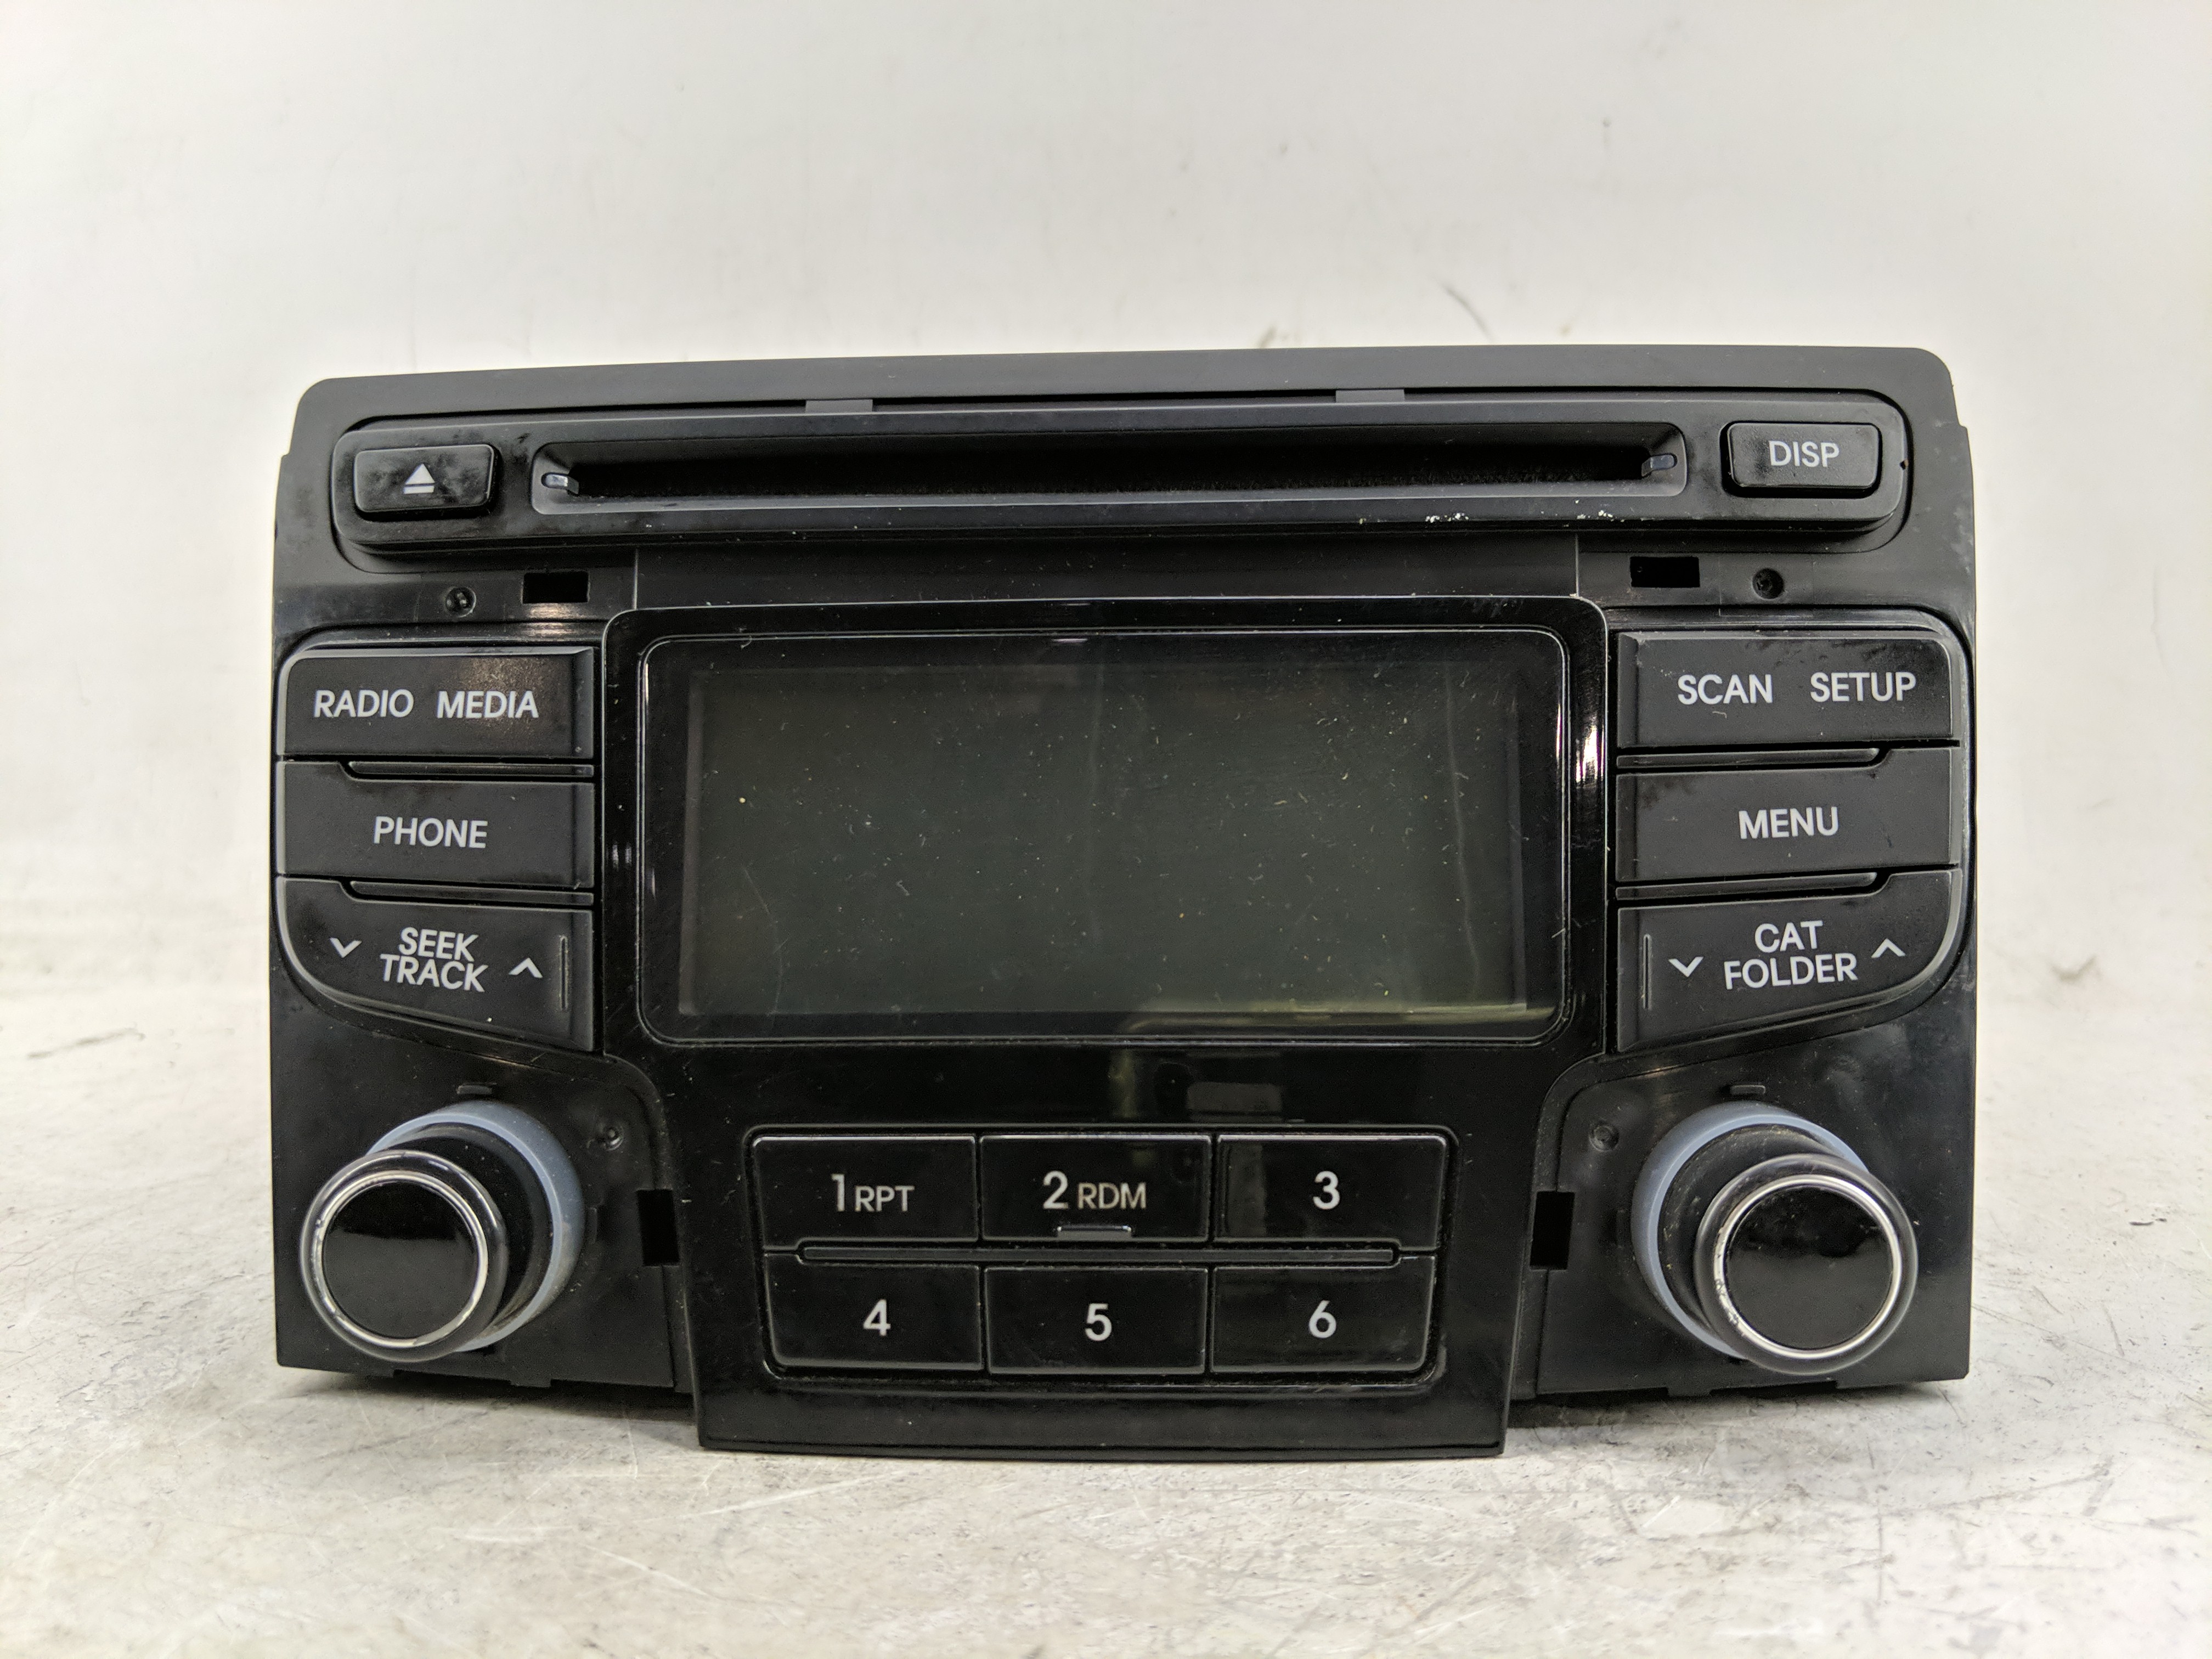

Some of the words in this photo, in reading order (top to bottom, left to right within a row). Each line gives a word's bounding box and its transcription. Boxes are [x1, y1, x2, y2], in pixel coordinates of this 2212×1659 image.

[1768, 440, 1840, 468] DISP
[314, 689, 415, 718] RADIO
[436, 690, 539, 719] MEDIA
[1677, 674, 1773, 706] SCAN
[1810, 671, 1917, 703] SETUP
[373, 815, 488, 849] PHONE
[1738, 806, 1839, 840] MENU
[398, 927, 479, 962] SEEK
[1754, 919, 1824, 953] CAT
[380, 953, 489, 992] TRACK
[1723, 953, 1859, 990] FOLDER
[831, 1173, 845, 1212] 1
[855, 1185, 915, 1212] RPT
[1043, 1170, 1069, 1210] 2
[1077, 1182, 1147, 1209] RDM
[1312, 1170, 1340, 1210] 3
[862, 1299, 891, 1336] 4
[1085, 1302, 1113, 1342] 5
[1308, 1300, 1337, 1339] 6
